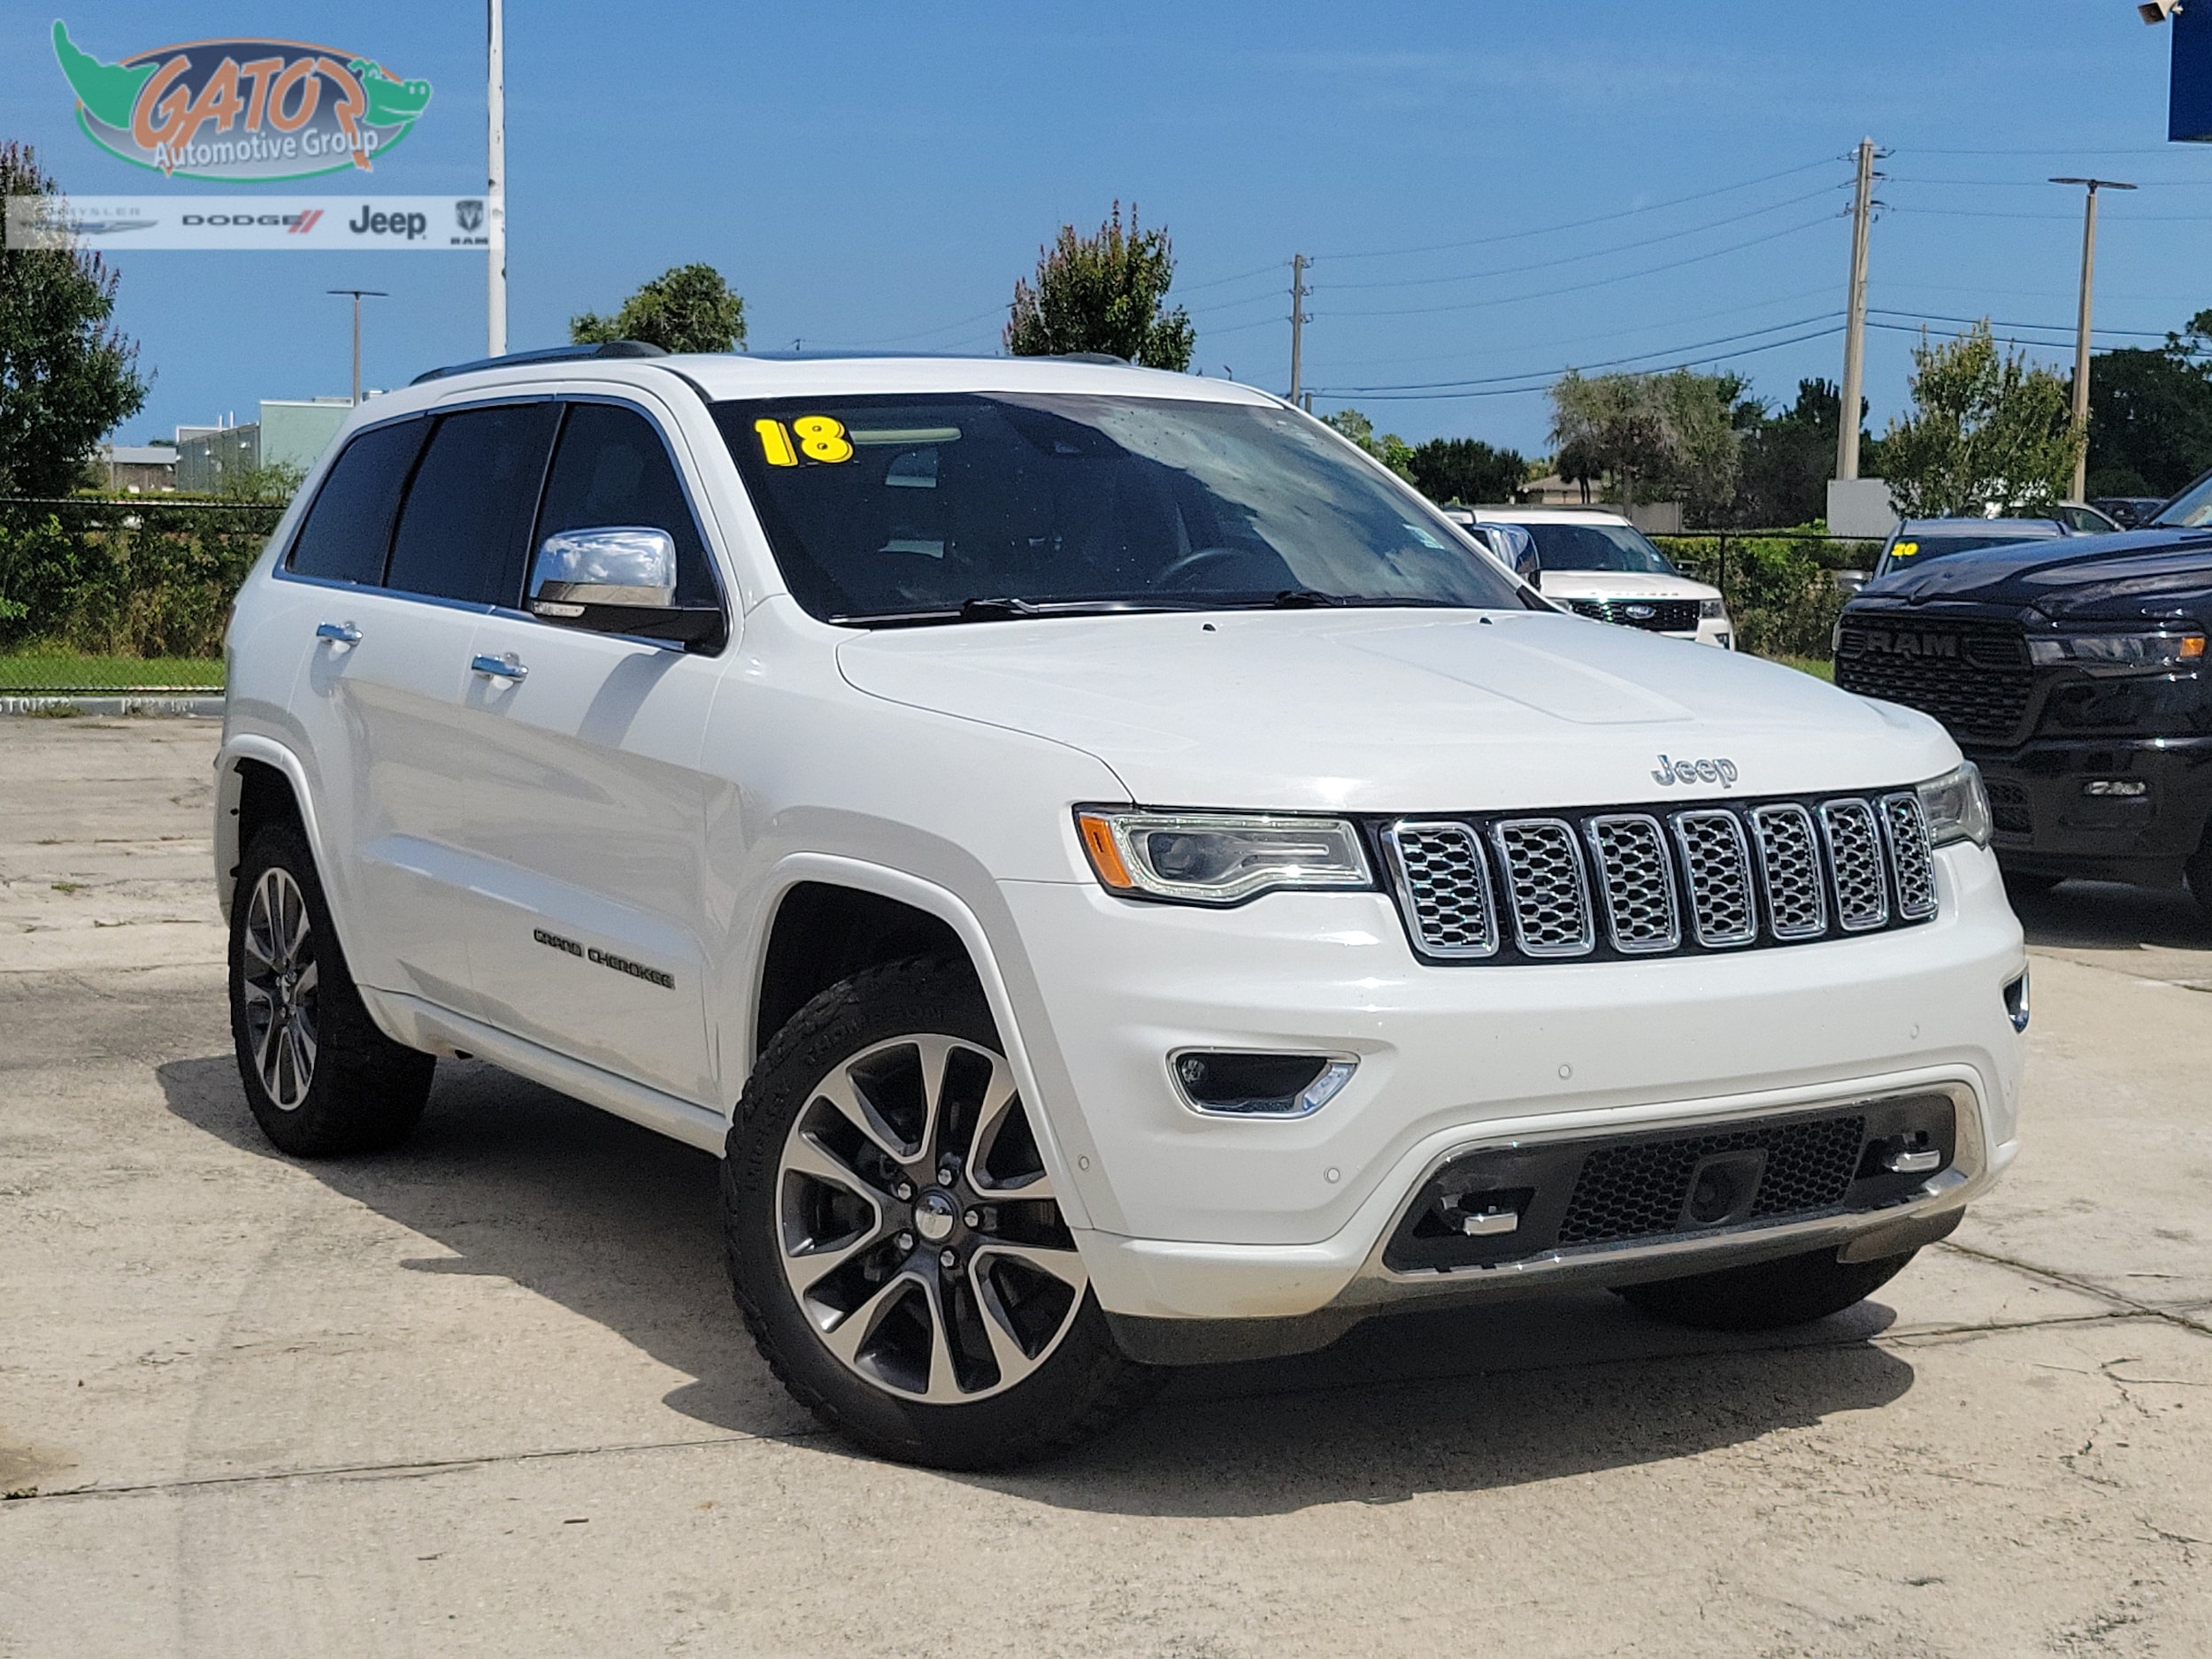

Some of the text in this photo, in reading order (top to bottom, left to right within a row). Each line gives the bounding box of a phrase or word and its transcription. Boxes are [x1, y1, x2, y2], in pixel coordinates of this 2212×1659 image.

[755, 415, 854, 466] 18
[1868, 631, 1956, 657] RAM
[1650, 754, 1738, 789] Jeep
[534, 928, 676, 990] GRAND CHEROKEE
